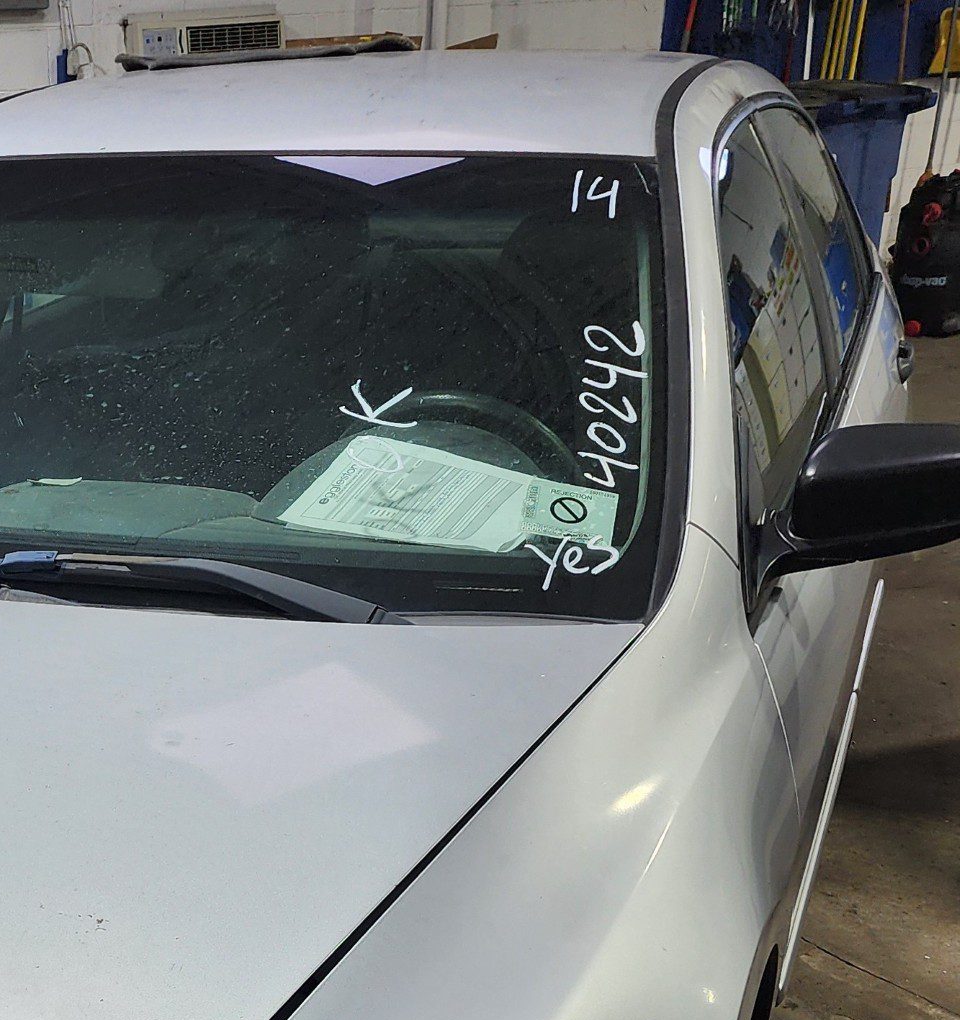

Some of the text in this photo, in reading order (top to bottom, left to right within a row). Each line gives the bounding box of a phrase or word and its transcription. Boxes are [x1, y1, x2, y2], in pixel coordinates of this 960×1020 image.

[571, 169, 620, 219] 14
[578, 320, 649, 487] 40242
[550, 488, 593, 501] REJECTION
